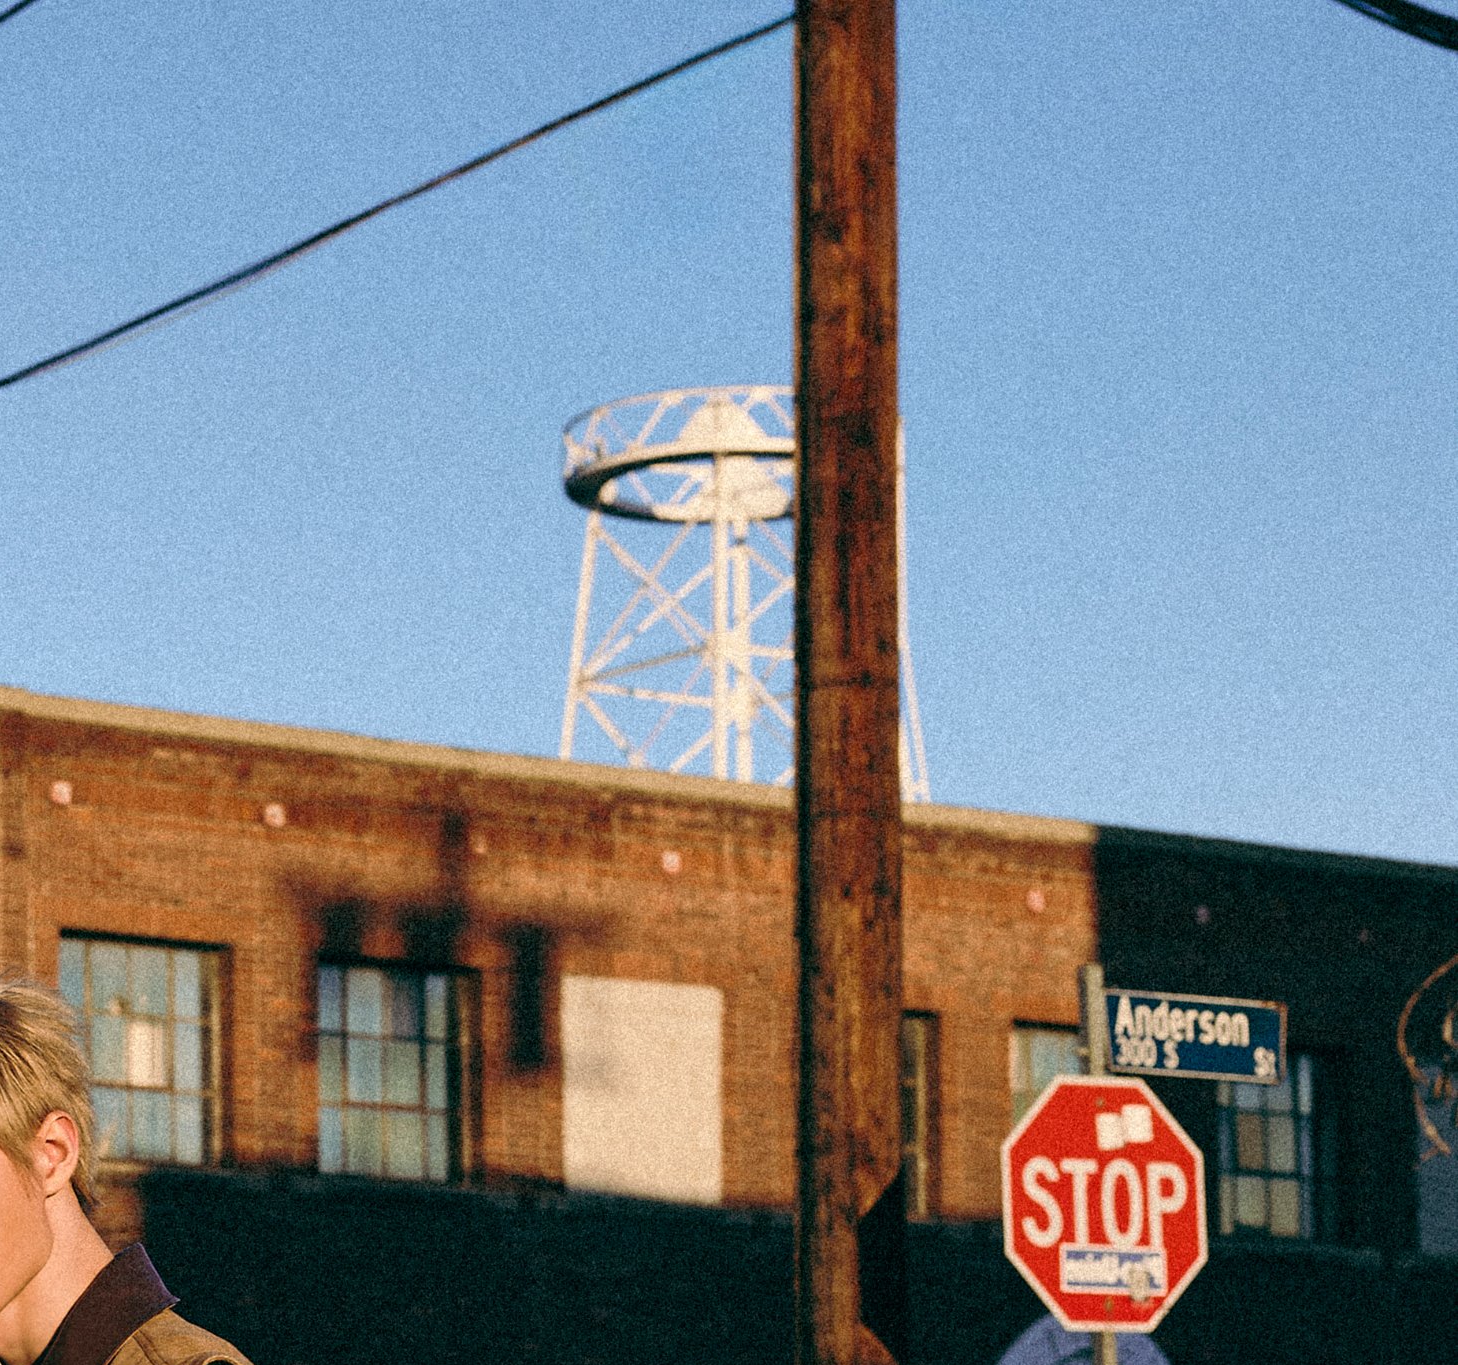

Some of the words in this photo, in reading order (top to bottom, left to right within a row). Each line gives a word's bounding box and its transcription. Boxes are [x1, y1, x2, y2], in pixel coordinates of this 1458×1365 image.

[1114, 994, 1250, 1048] Anderson
[1163, 1038, 1180, 1069] S
[1021, 1156, 1189, 1248] STOP
